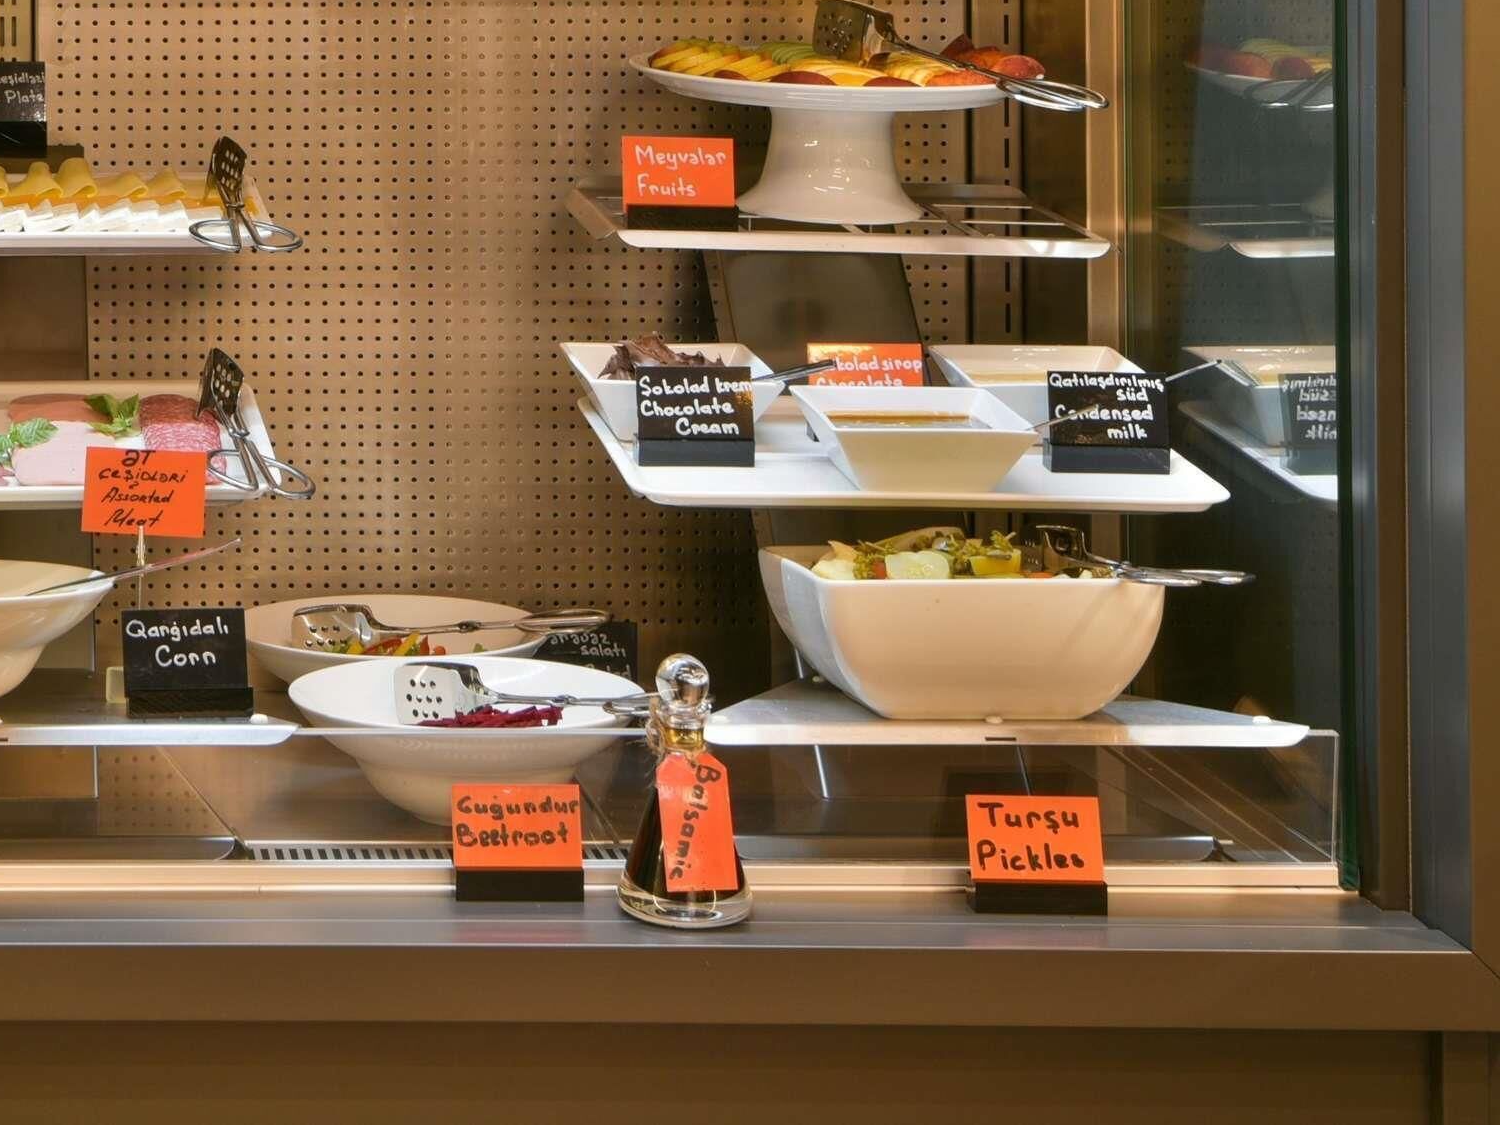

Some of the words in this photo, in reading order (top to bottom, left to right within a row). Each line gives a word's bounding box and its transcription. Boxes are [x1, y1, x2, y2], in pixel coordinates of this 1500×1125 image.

[4, 89, 44, 104] Plate
[637, 173, 697, 197] Fruits
[882, 358, 922, 373] sirop
[715, 377, 752, 394] krem
[640, 397, 735, 416] Chocolate
[1055, 404, 1154, 421] Condensed
[675, 417, 740, 436] Cream
[1107, 423, 1148, 439] milk
[104, 508, 163, 528] Meat
[155, 644, 217, 667] Corn
[669, 763, 722, 881] Balsamic
[977, 802, 1079, 835] Turşu
[456, 821, 568, 847] Beetroot
[976, 839, 1085, 871] Pickles
